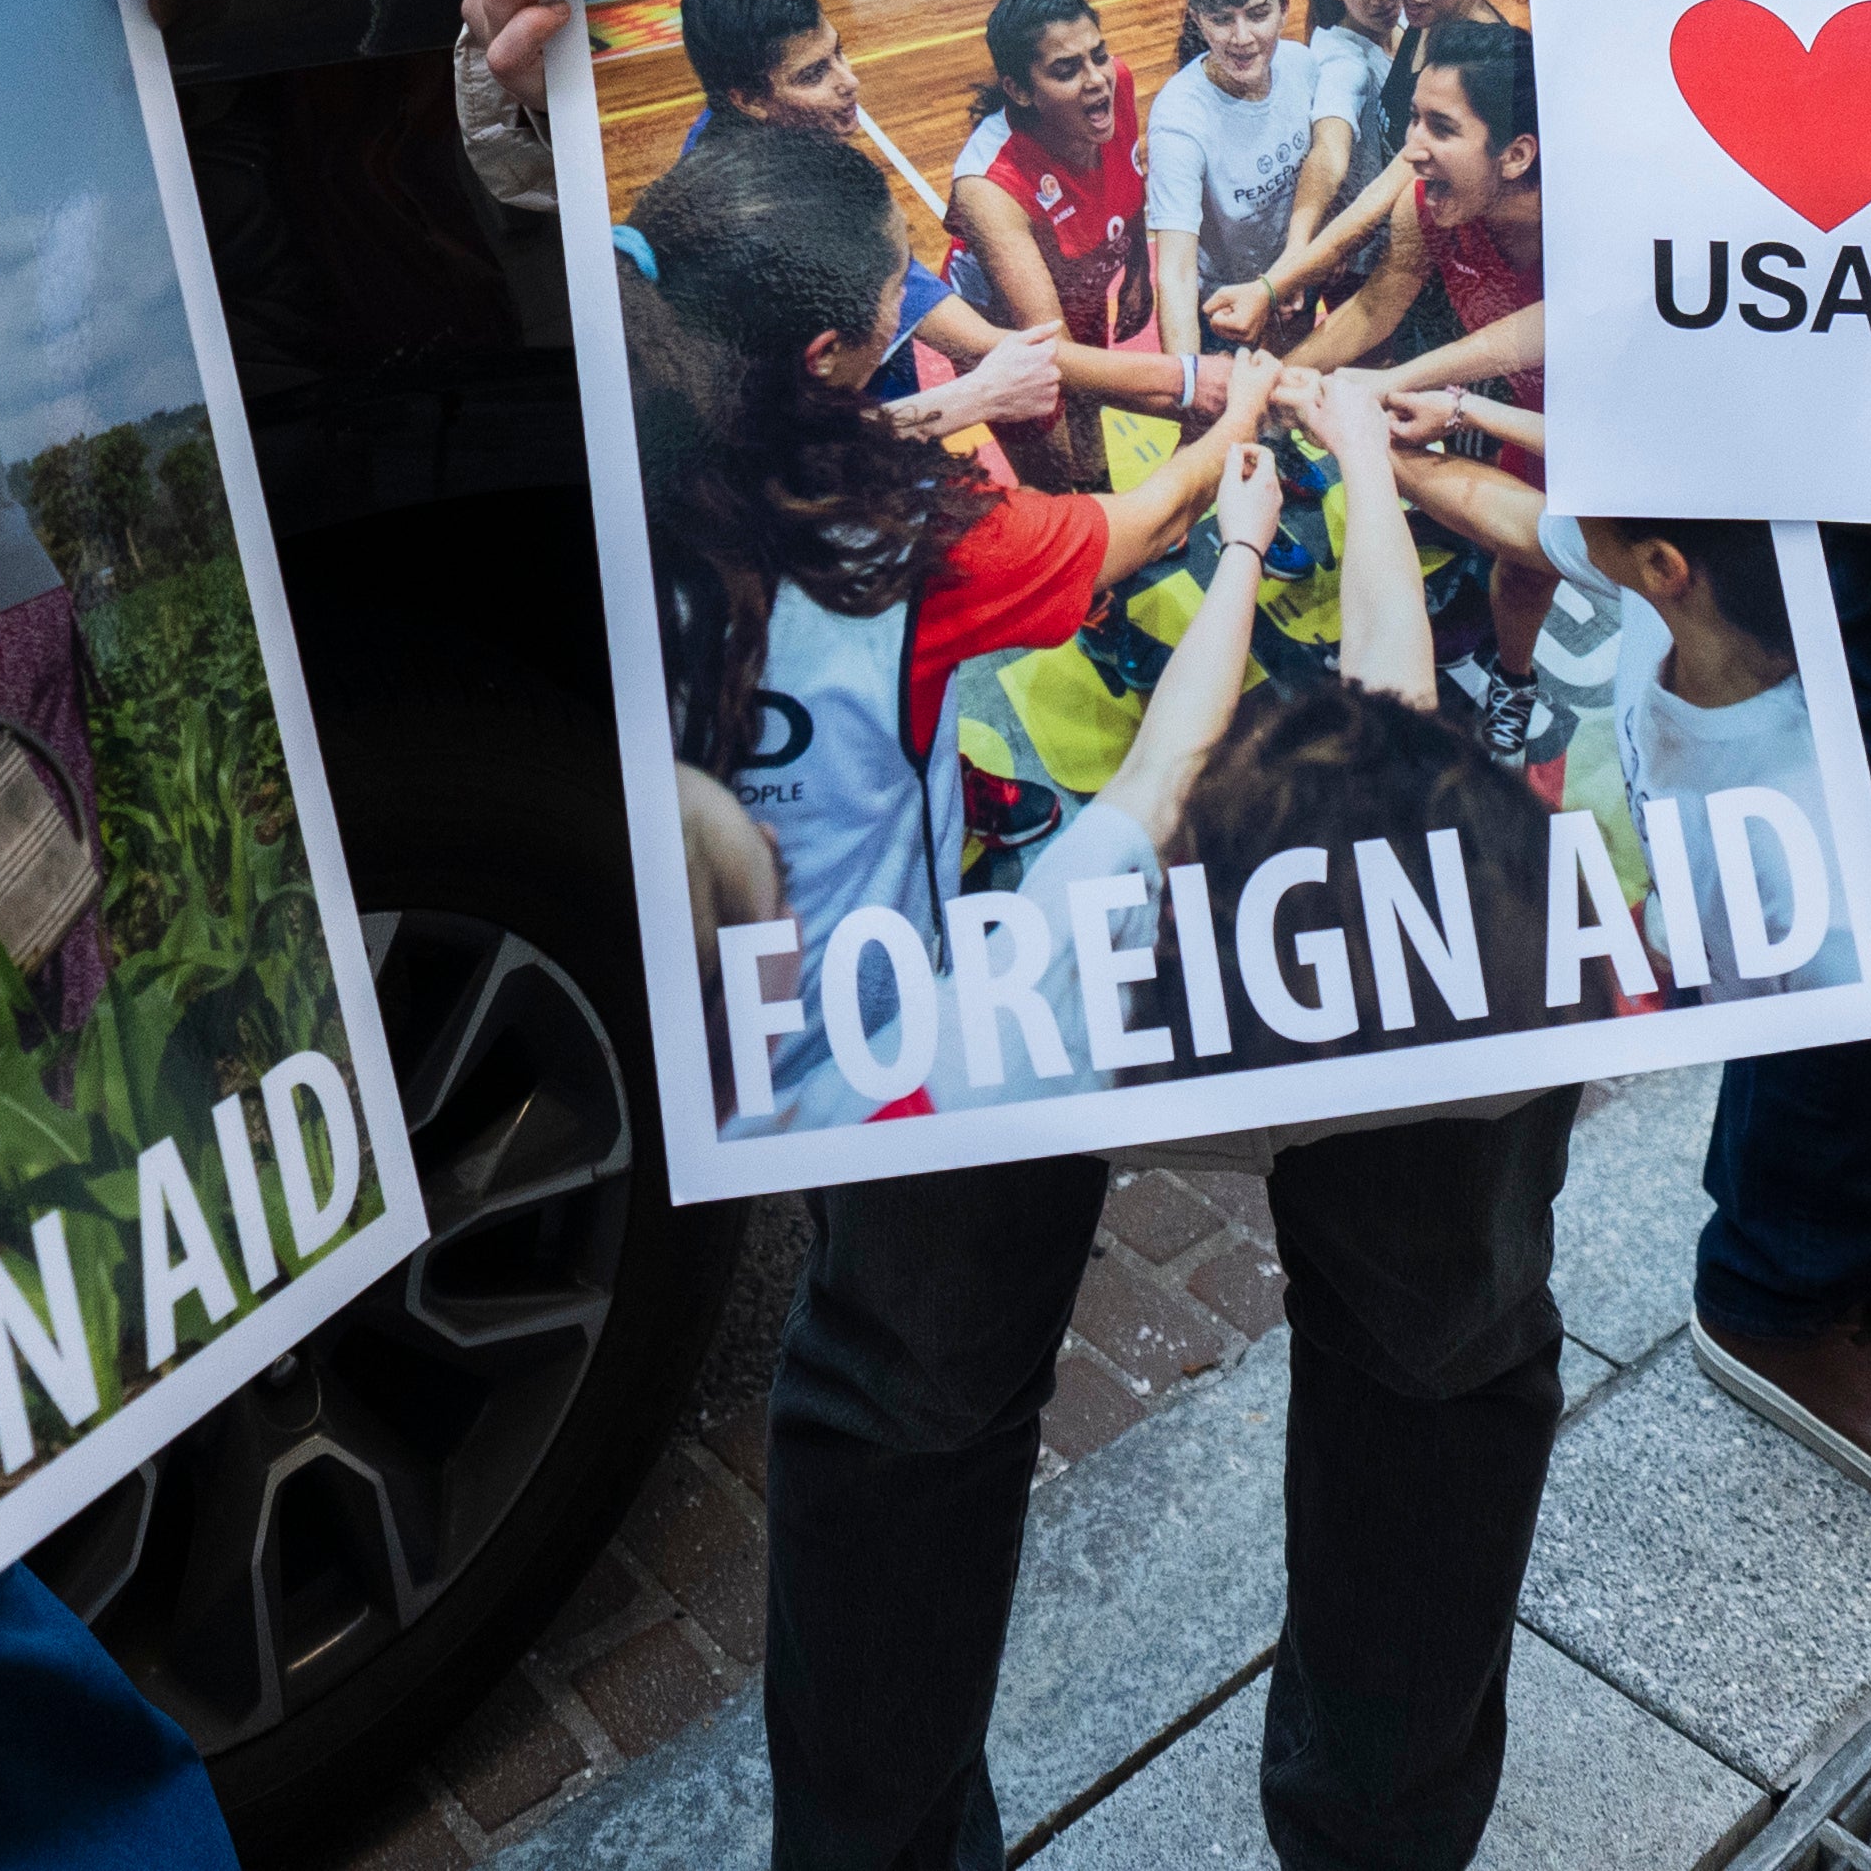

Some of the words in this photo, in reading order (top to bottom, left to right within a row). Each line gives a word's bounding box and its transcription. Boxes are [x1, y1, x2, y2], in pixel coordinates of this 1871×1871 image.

[717, 830, 1489, 1119] FOREIGN
[1546, 786, 1831, 1009] AID
[137, 1048, 364, 1369] AID
